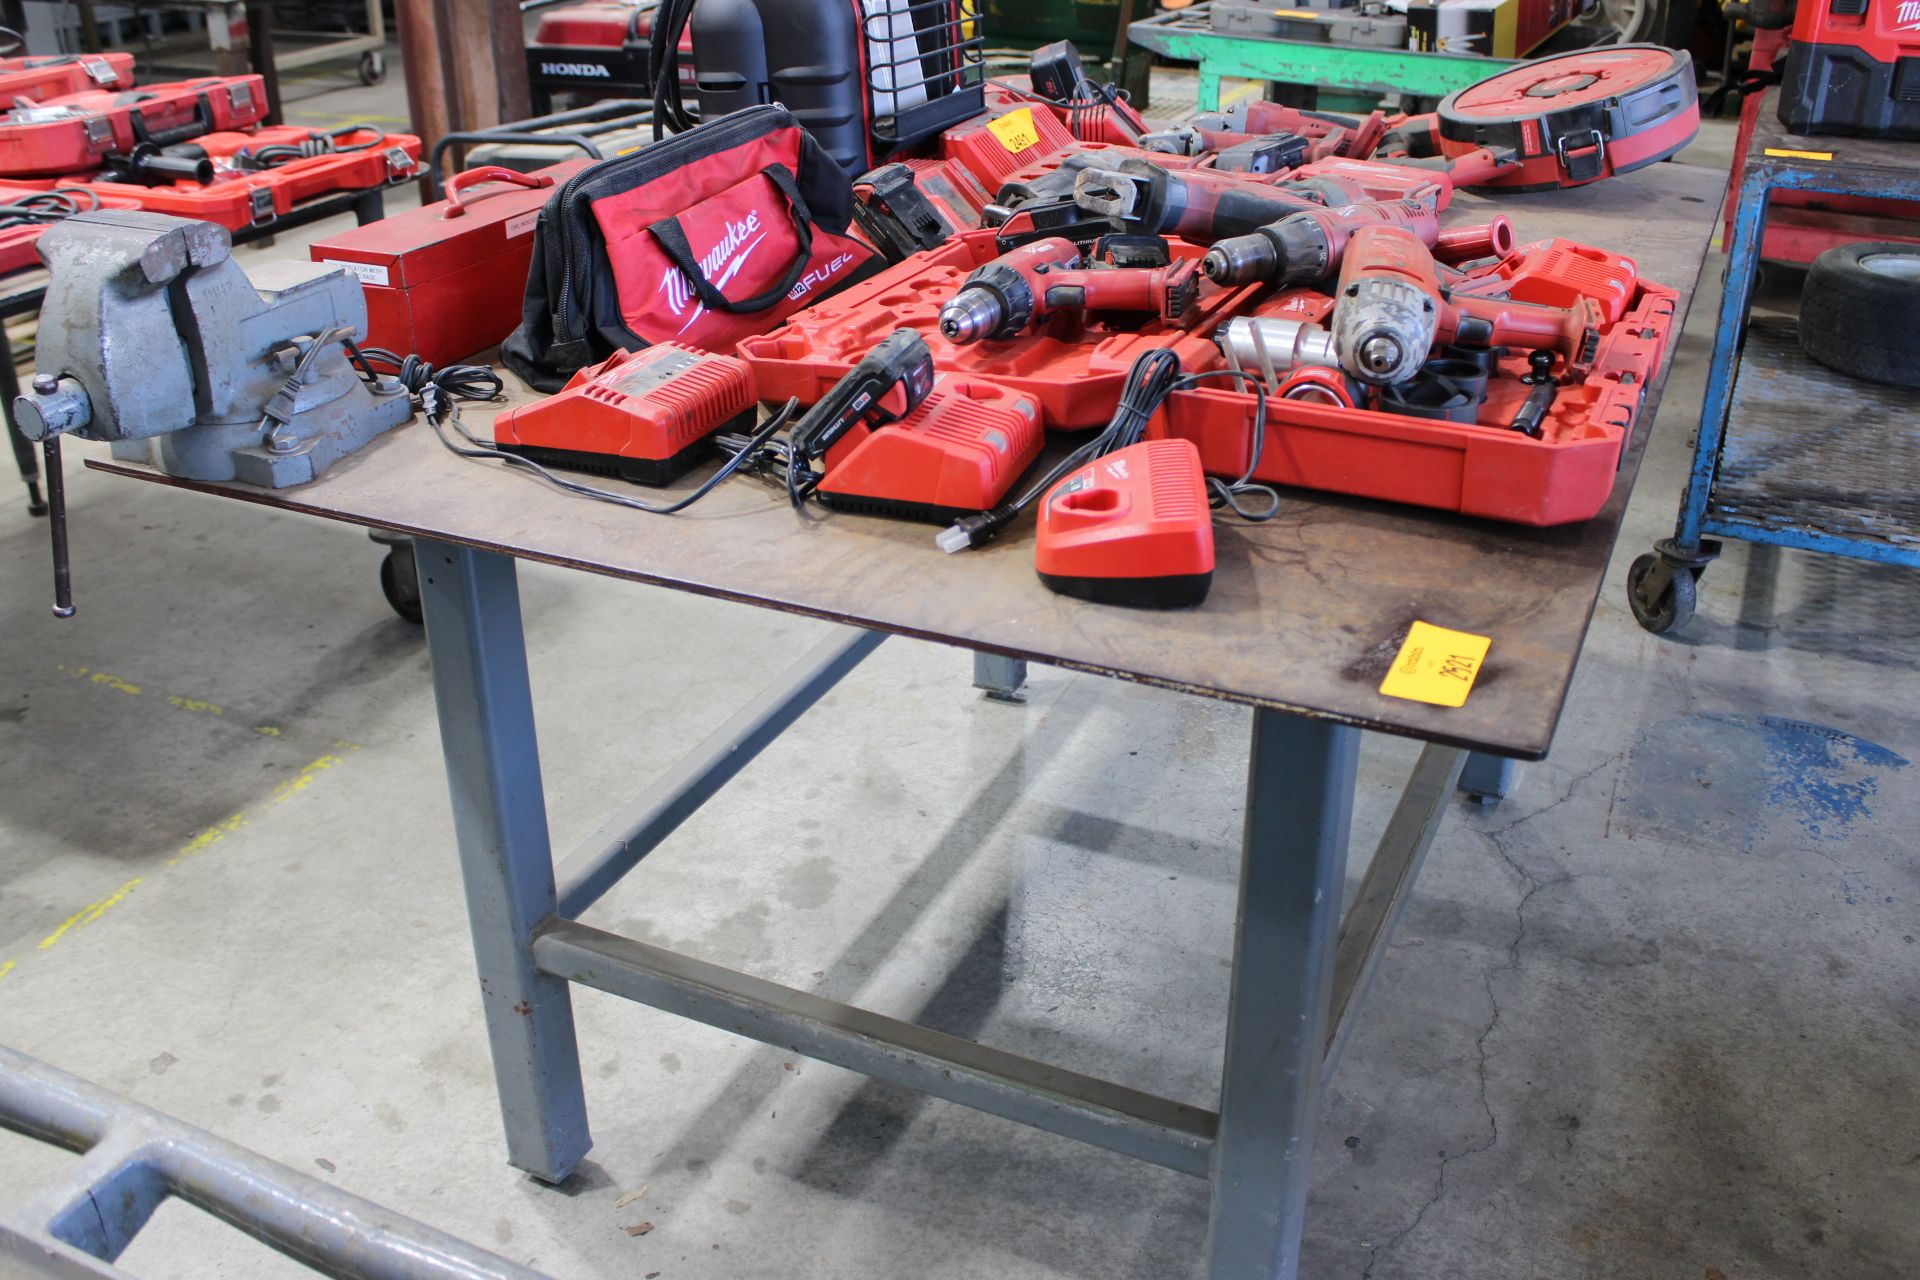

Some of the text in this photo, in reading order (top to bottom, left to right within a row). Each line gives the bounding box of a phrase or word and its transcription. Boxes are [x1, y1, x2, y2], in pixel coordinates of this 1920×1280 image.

[541, 63, 611, 77] HONDA
[658, 210, 761, 315] Mwaukee
[788, 252, 853, 300] M12 FUEL
[1438, 654, 1475, 681] 2521
